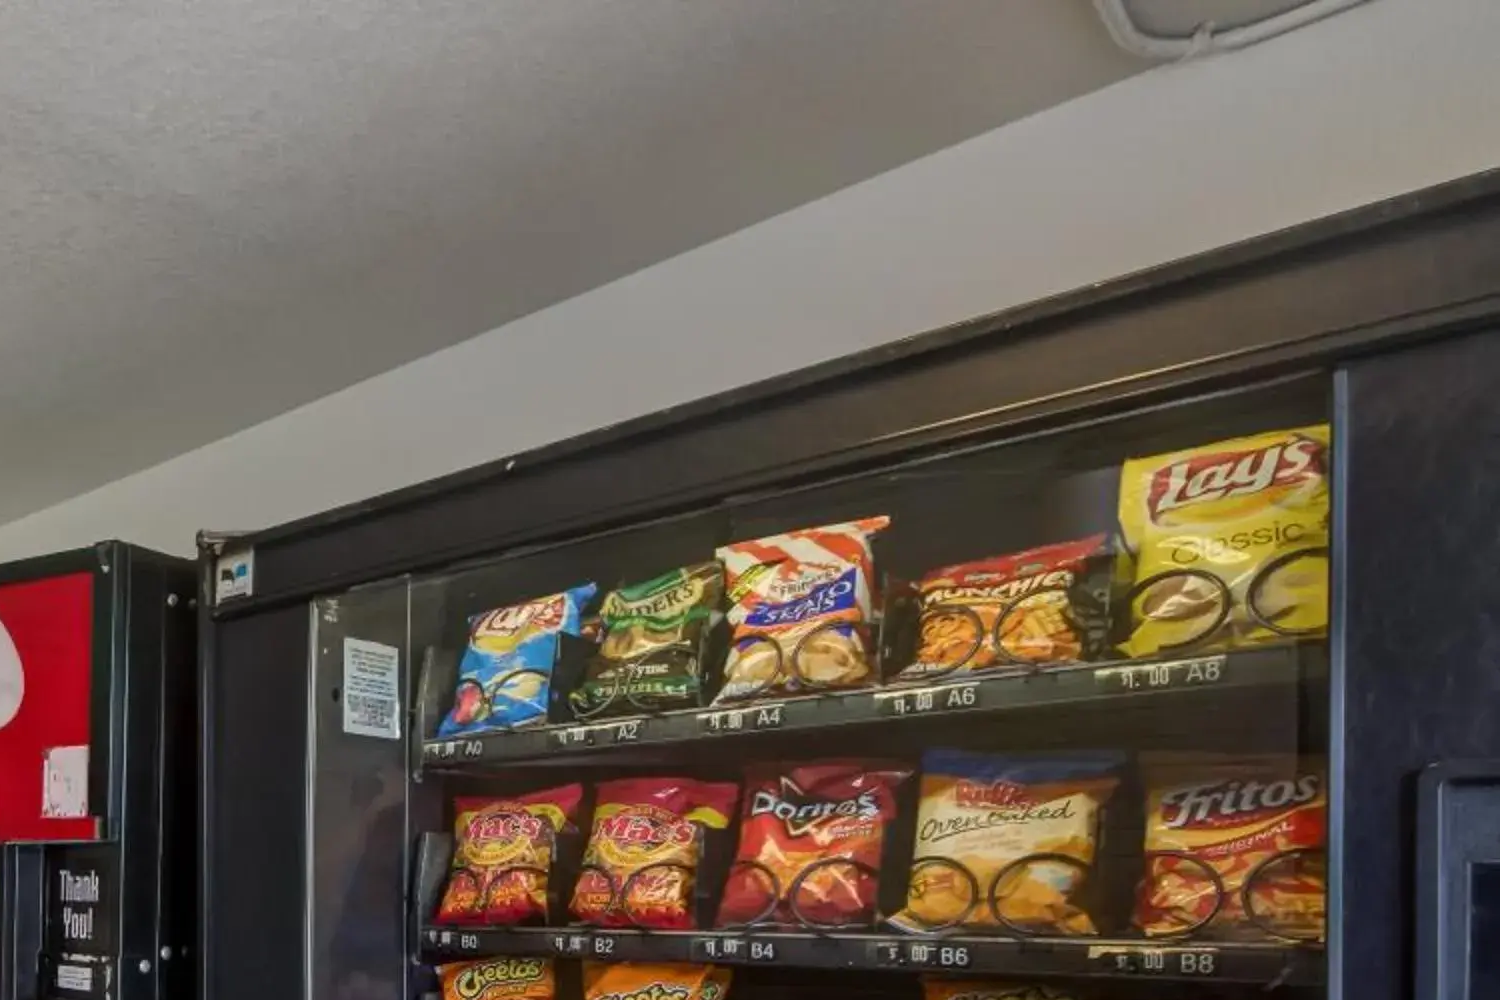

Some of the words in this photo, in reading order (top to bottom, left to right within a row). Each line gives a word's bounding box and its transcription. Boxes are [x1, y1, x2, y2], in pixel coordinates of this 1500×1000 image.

[1186, 661, 1221, 682] A8
[947, 687, 976, 707] A6
[756, 708, 782, 726] A4
[617, 725, 638, 741] A2
[1161, 775, 1320, 829] Fritos
[59, 869, 100, 901] Thank
[63, 907, 93, 940] You!
[594, 937, 614, 953] B2
[751, 942, 775, 960] B4
[940, 947, 969, 966] B6
[1180, 952, 1214, 974] B8
[456, 957, 544, 1000] Cheetos
